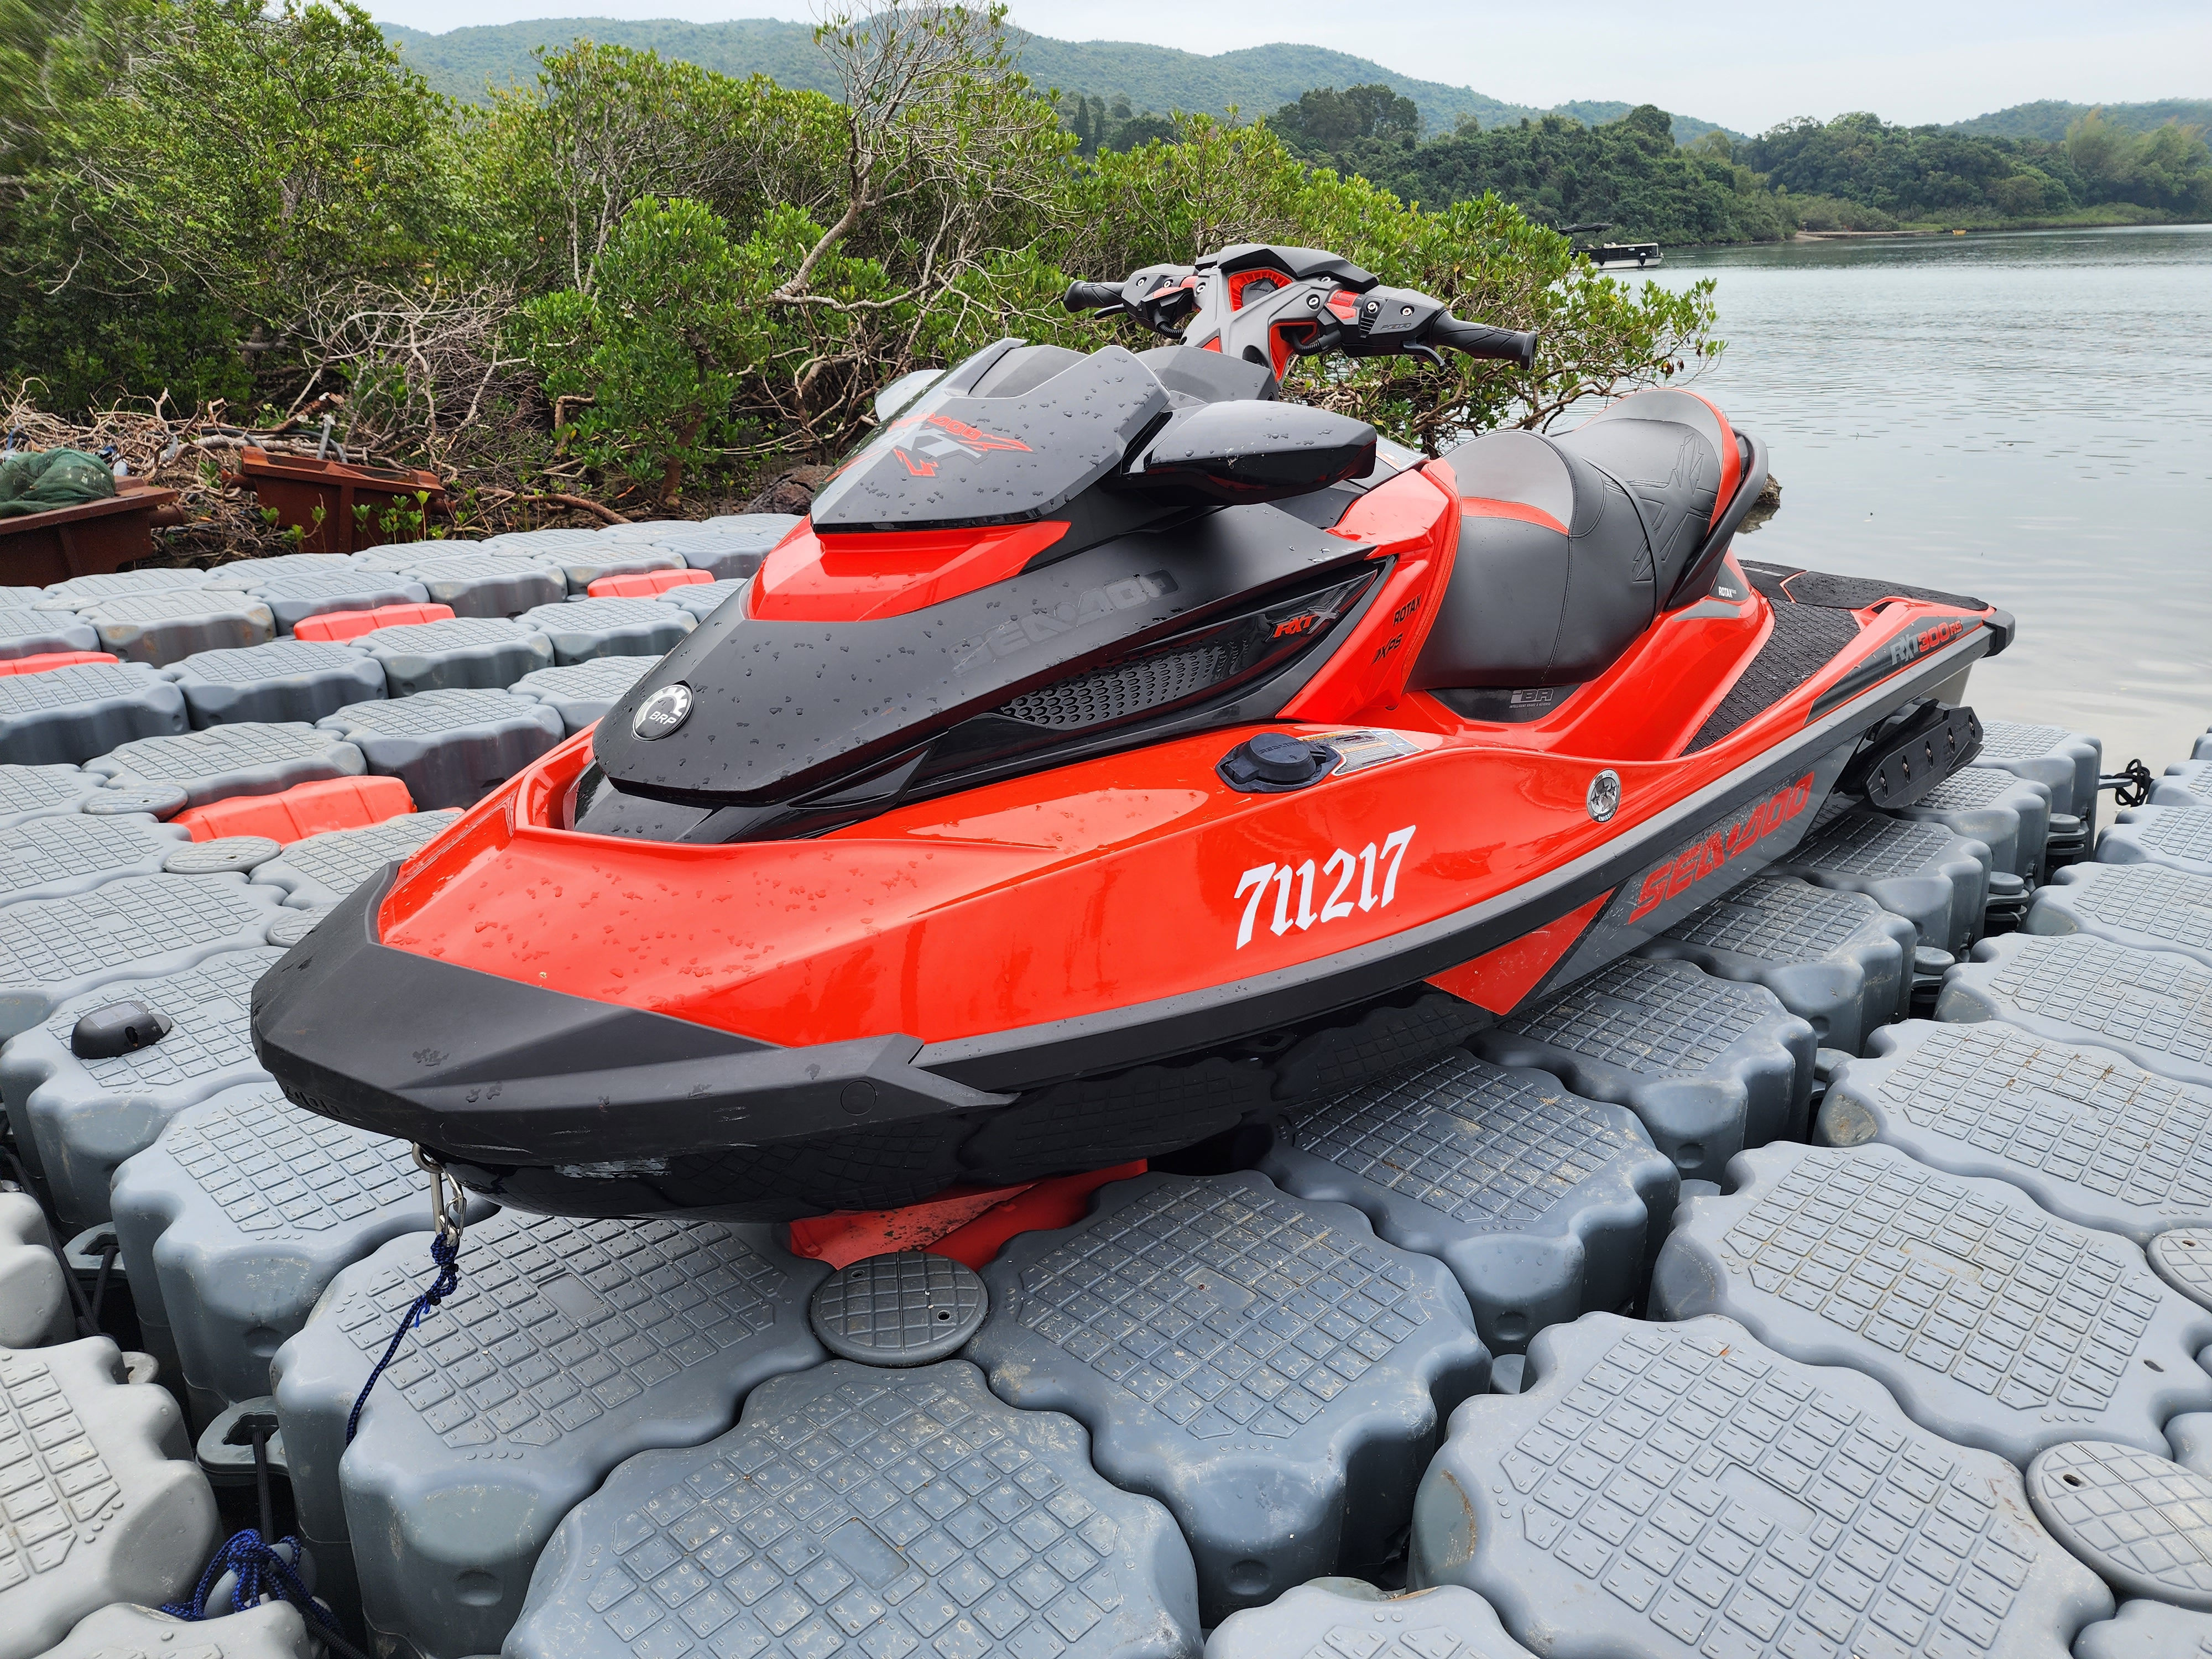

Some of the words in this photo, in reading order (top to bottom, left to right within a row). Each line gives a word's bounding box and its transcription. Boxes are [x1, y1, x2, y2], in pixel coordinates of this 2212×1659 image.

[1718, 586, 1733, 598] ROTAX
[1392, 592, 1422, 627] ROTAX
[1370, 633, 1404, 664] XPS
[648, 710, 677, 726] BRP
[1598, 807, 1616, 822] EMISSION
[1234, 825, 1416, 950] 711217
